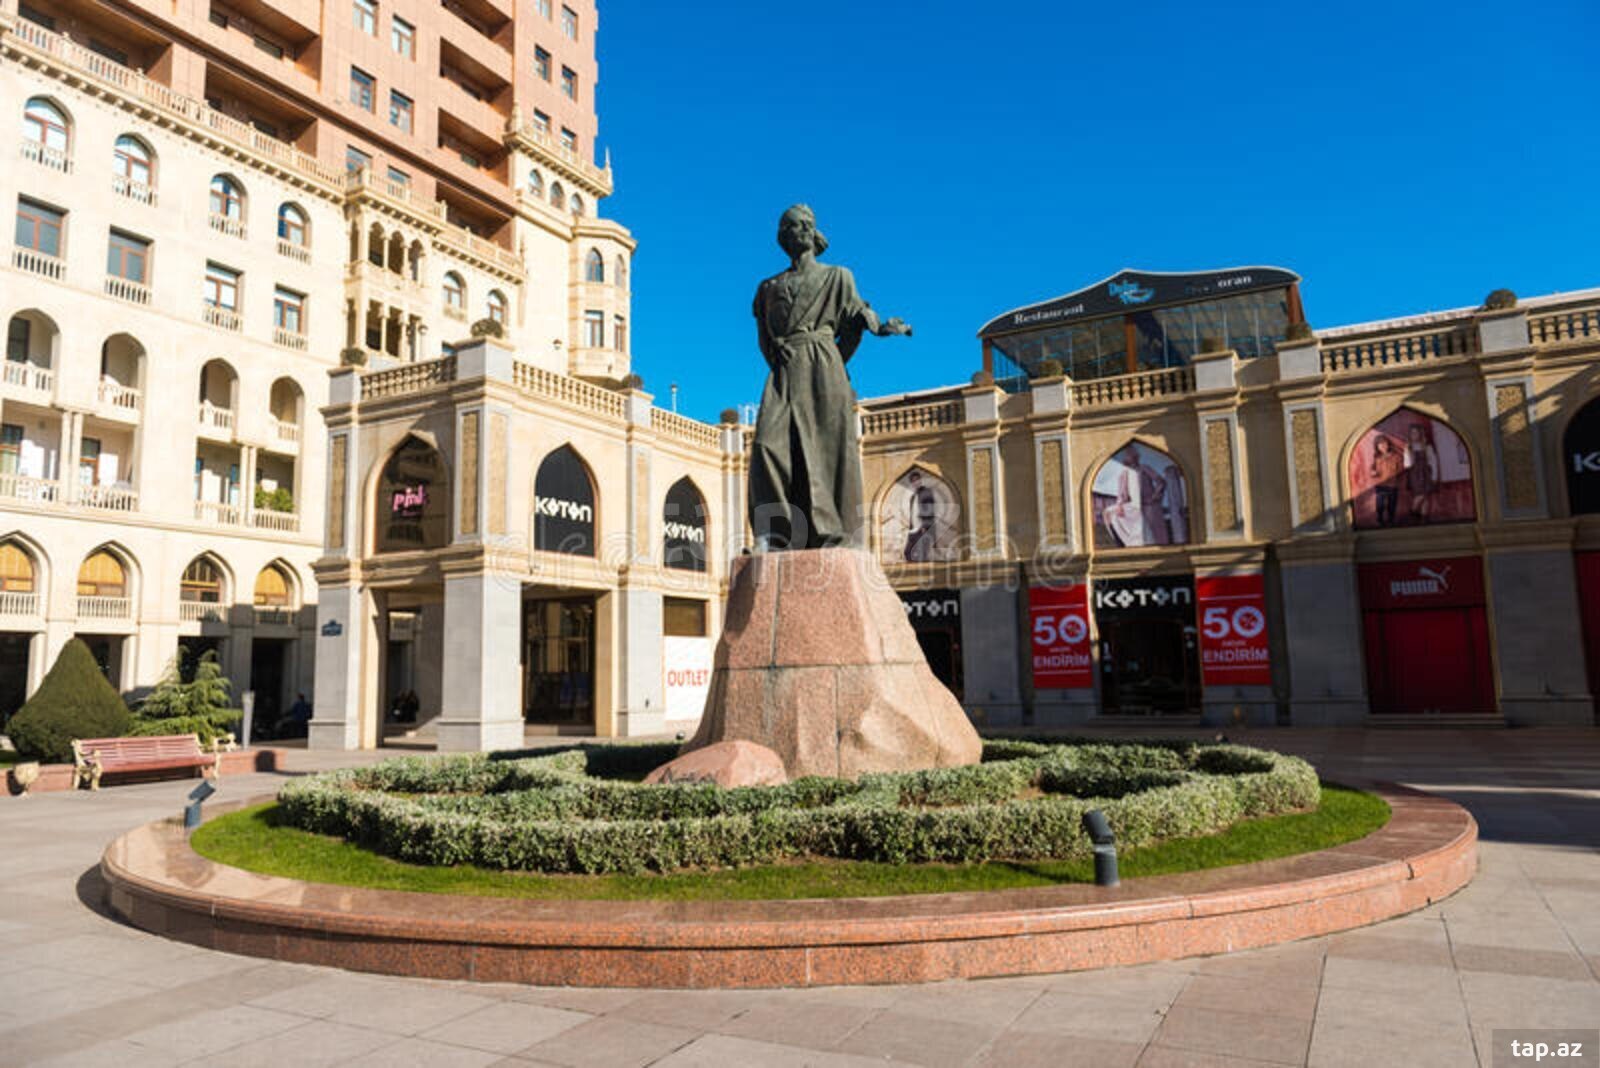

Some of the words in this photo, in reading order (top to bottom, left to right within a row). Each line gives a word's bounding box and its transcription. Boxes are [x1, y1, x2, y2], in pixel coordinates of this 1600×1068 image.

[535, 496, 592, 522] KOTON
[1096, 587, 1190, 608] KOTON
[667, 669, 709, 687] OUTLET
